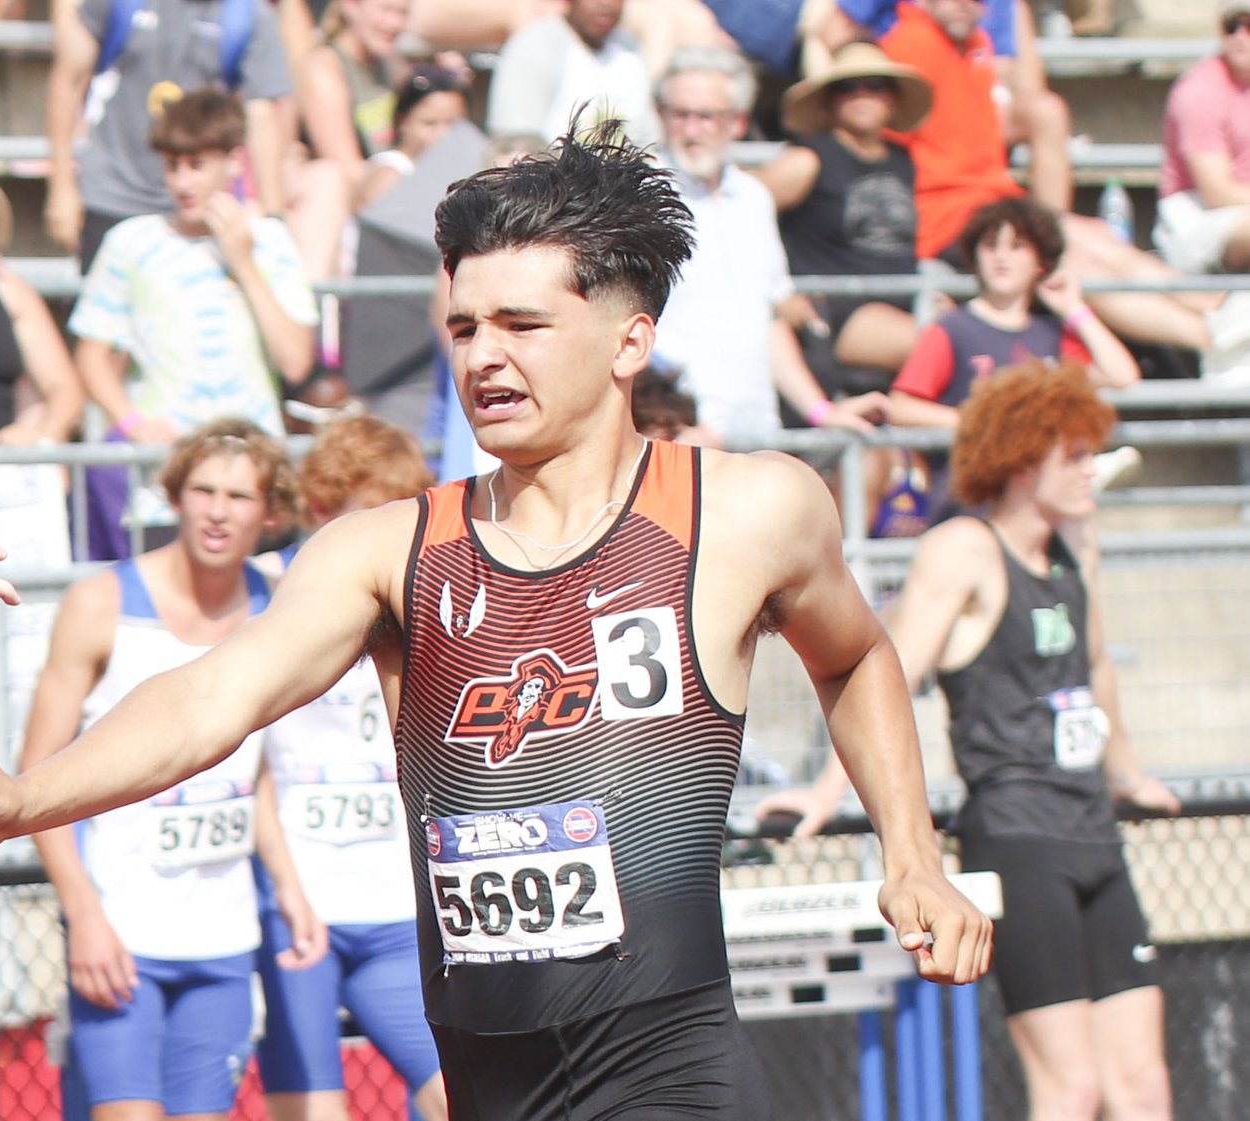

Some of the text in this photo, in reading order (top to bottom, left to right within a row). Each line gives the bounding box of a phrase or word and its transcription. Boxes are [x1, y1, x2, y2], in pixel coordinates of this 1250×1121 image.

[608, 617, 668, 709] 3
[359, 693, 381, 742] 6
[159, 807, 249, 851] 5789
[306, 793, 395, 829] 5793
[454, 817, 549, 855] ZERO
[434, 861, 605, 937] 5692
